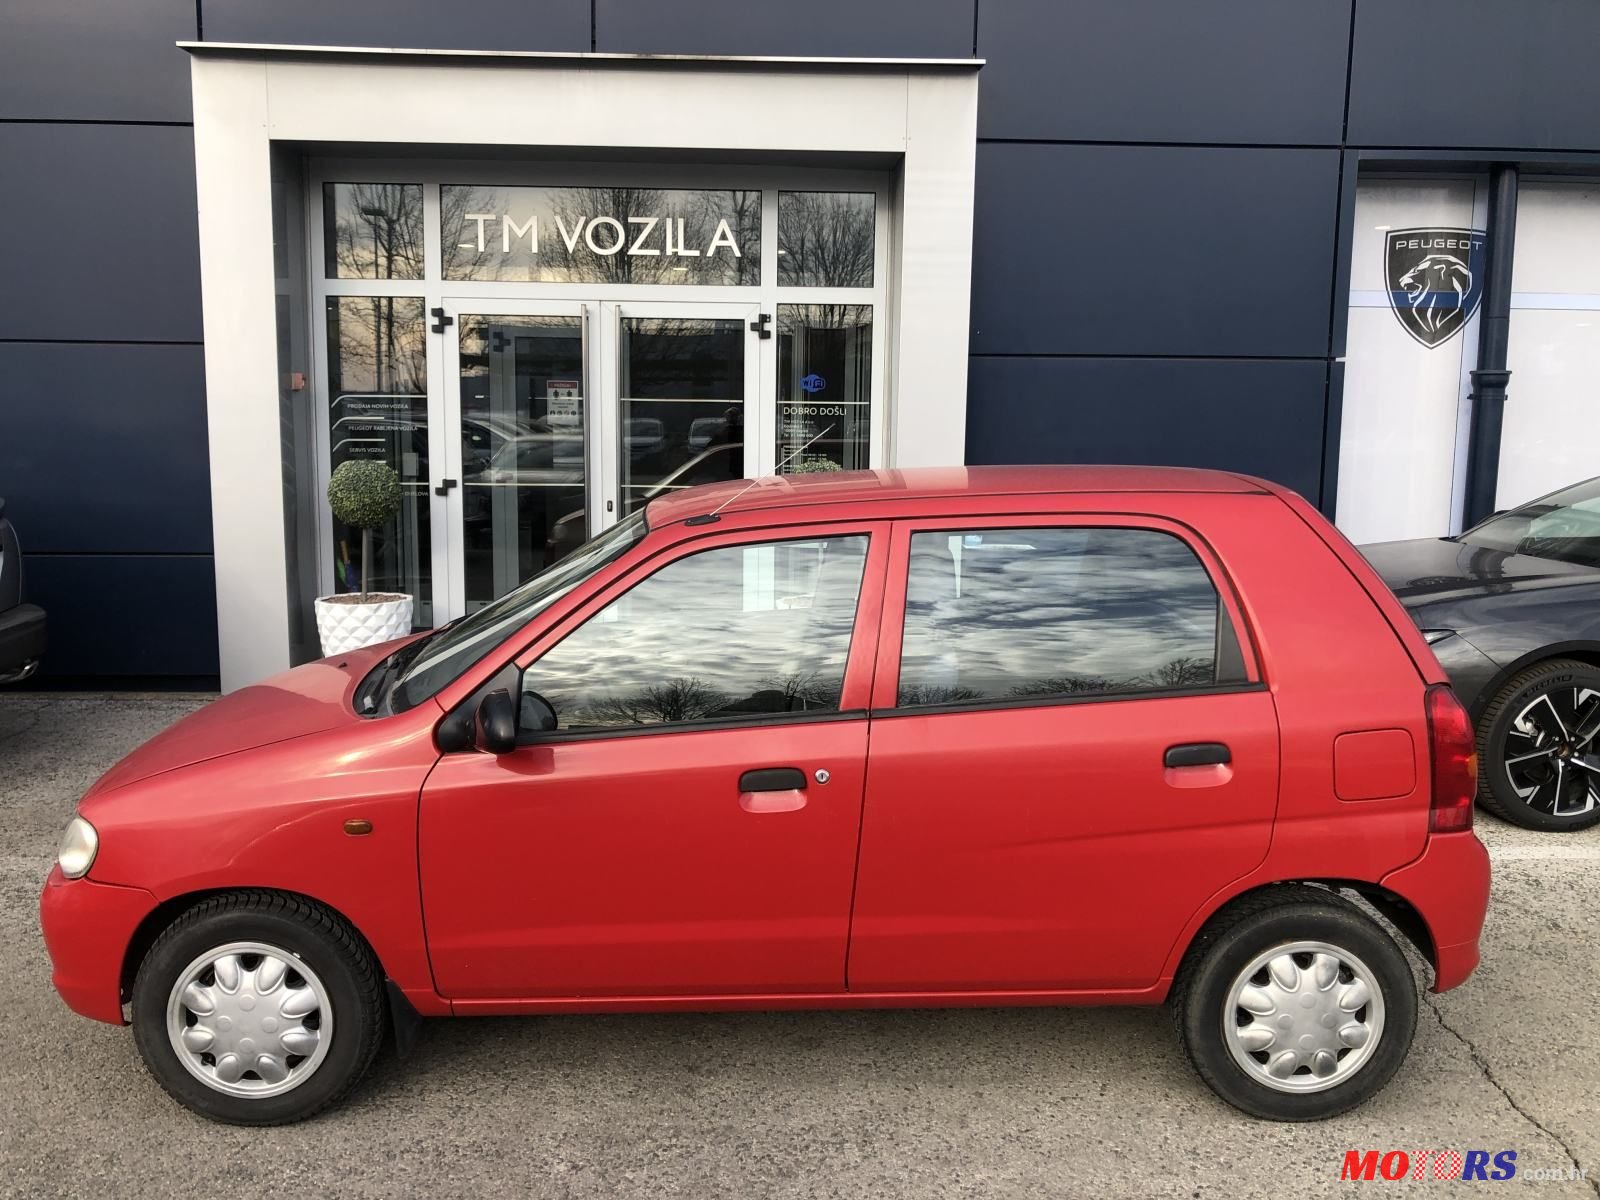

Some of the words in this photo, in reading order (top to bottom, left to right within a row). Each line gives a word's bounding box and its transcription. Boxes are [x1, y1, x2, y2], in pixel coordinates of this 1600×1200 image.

[464, 213, 538, 253] TM
[554, 215, 742, 258] VOZILA
[1395, 238, 1483, 251] PEUGEOT
[783, 406, 818, 416] DOBRO
[819, 405, 847, 416] DOŠLI
